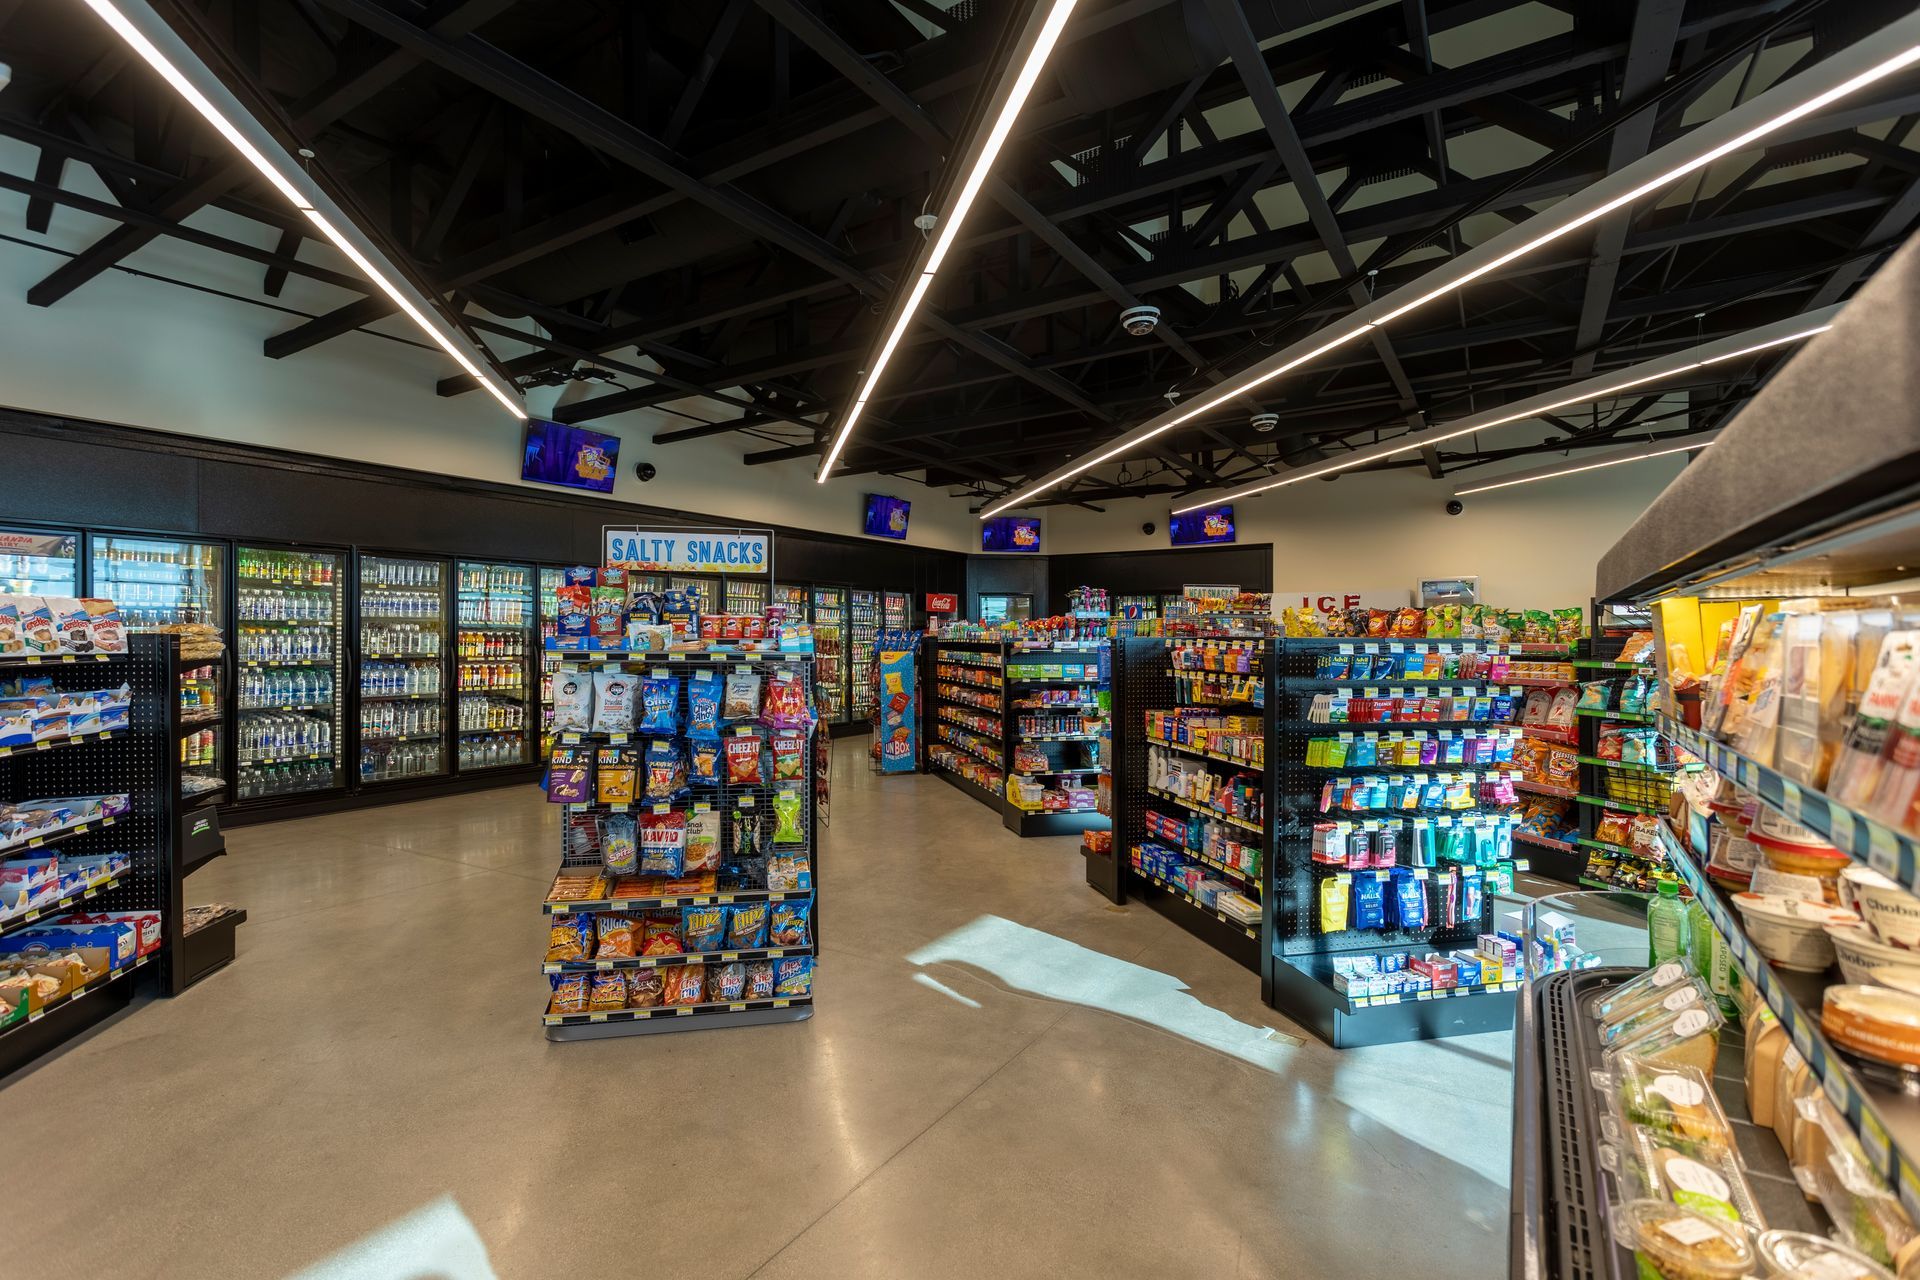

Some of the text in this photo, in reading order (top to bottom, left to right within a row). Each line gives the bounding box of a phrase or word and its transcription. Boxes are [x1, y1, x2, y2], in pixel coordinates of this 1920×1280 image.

[612, 539, 763, 564] SALTY SNACKS
[1303, 594, 1360, 613] ICE
[608, 846, 634, 863] Spitz
[1361, 892, 1380, 900] HALLS
[686, 911, 722, 933] Flipz
[779, 960, 801, 973] Chex
[680, 976, 700, 989] Chex
[720, 976, 742, 988] Chex
[753, 973, 773, 984] Chex
[681, 985, 700, 1000] mix
[722, 984, 741, 997] mix
[754, 982, 773, 993] mix
